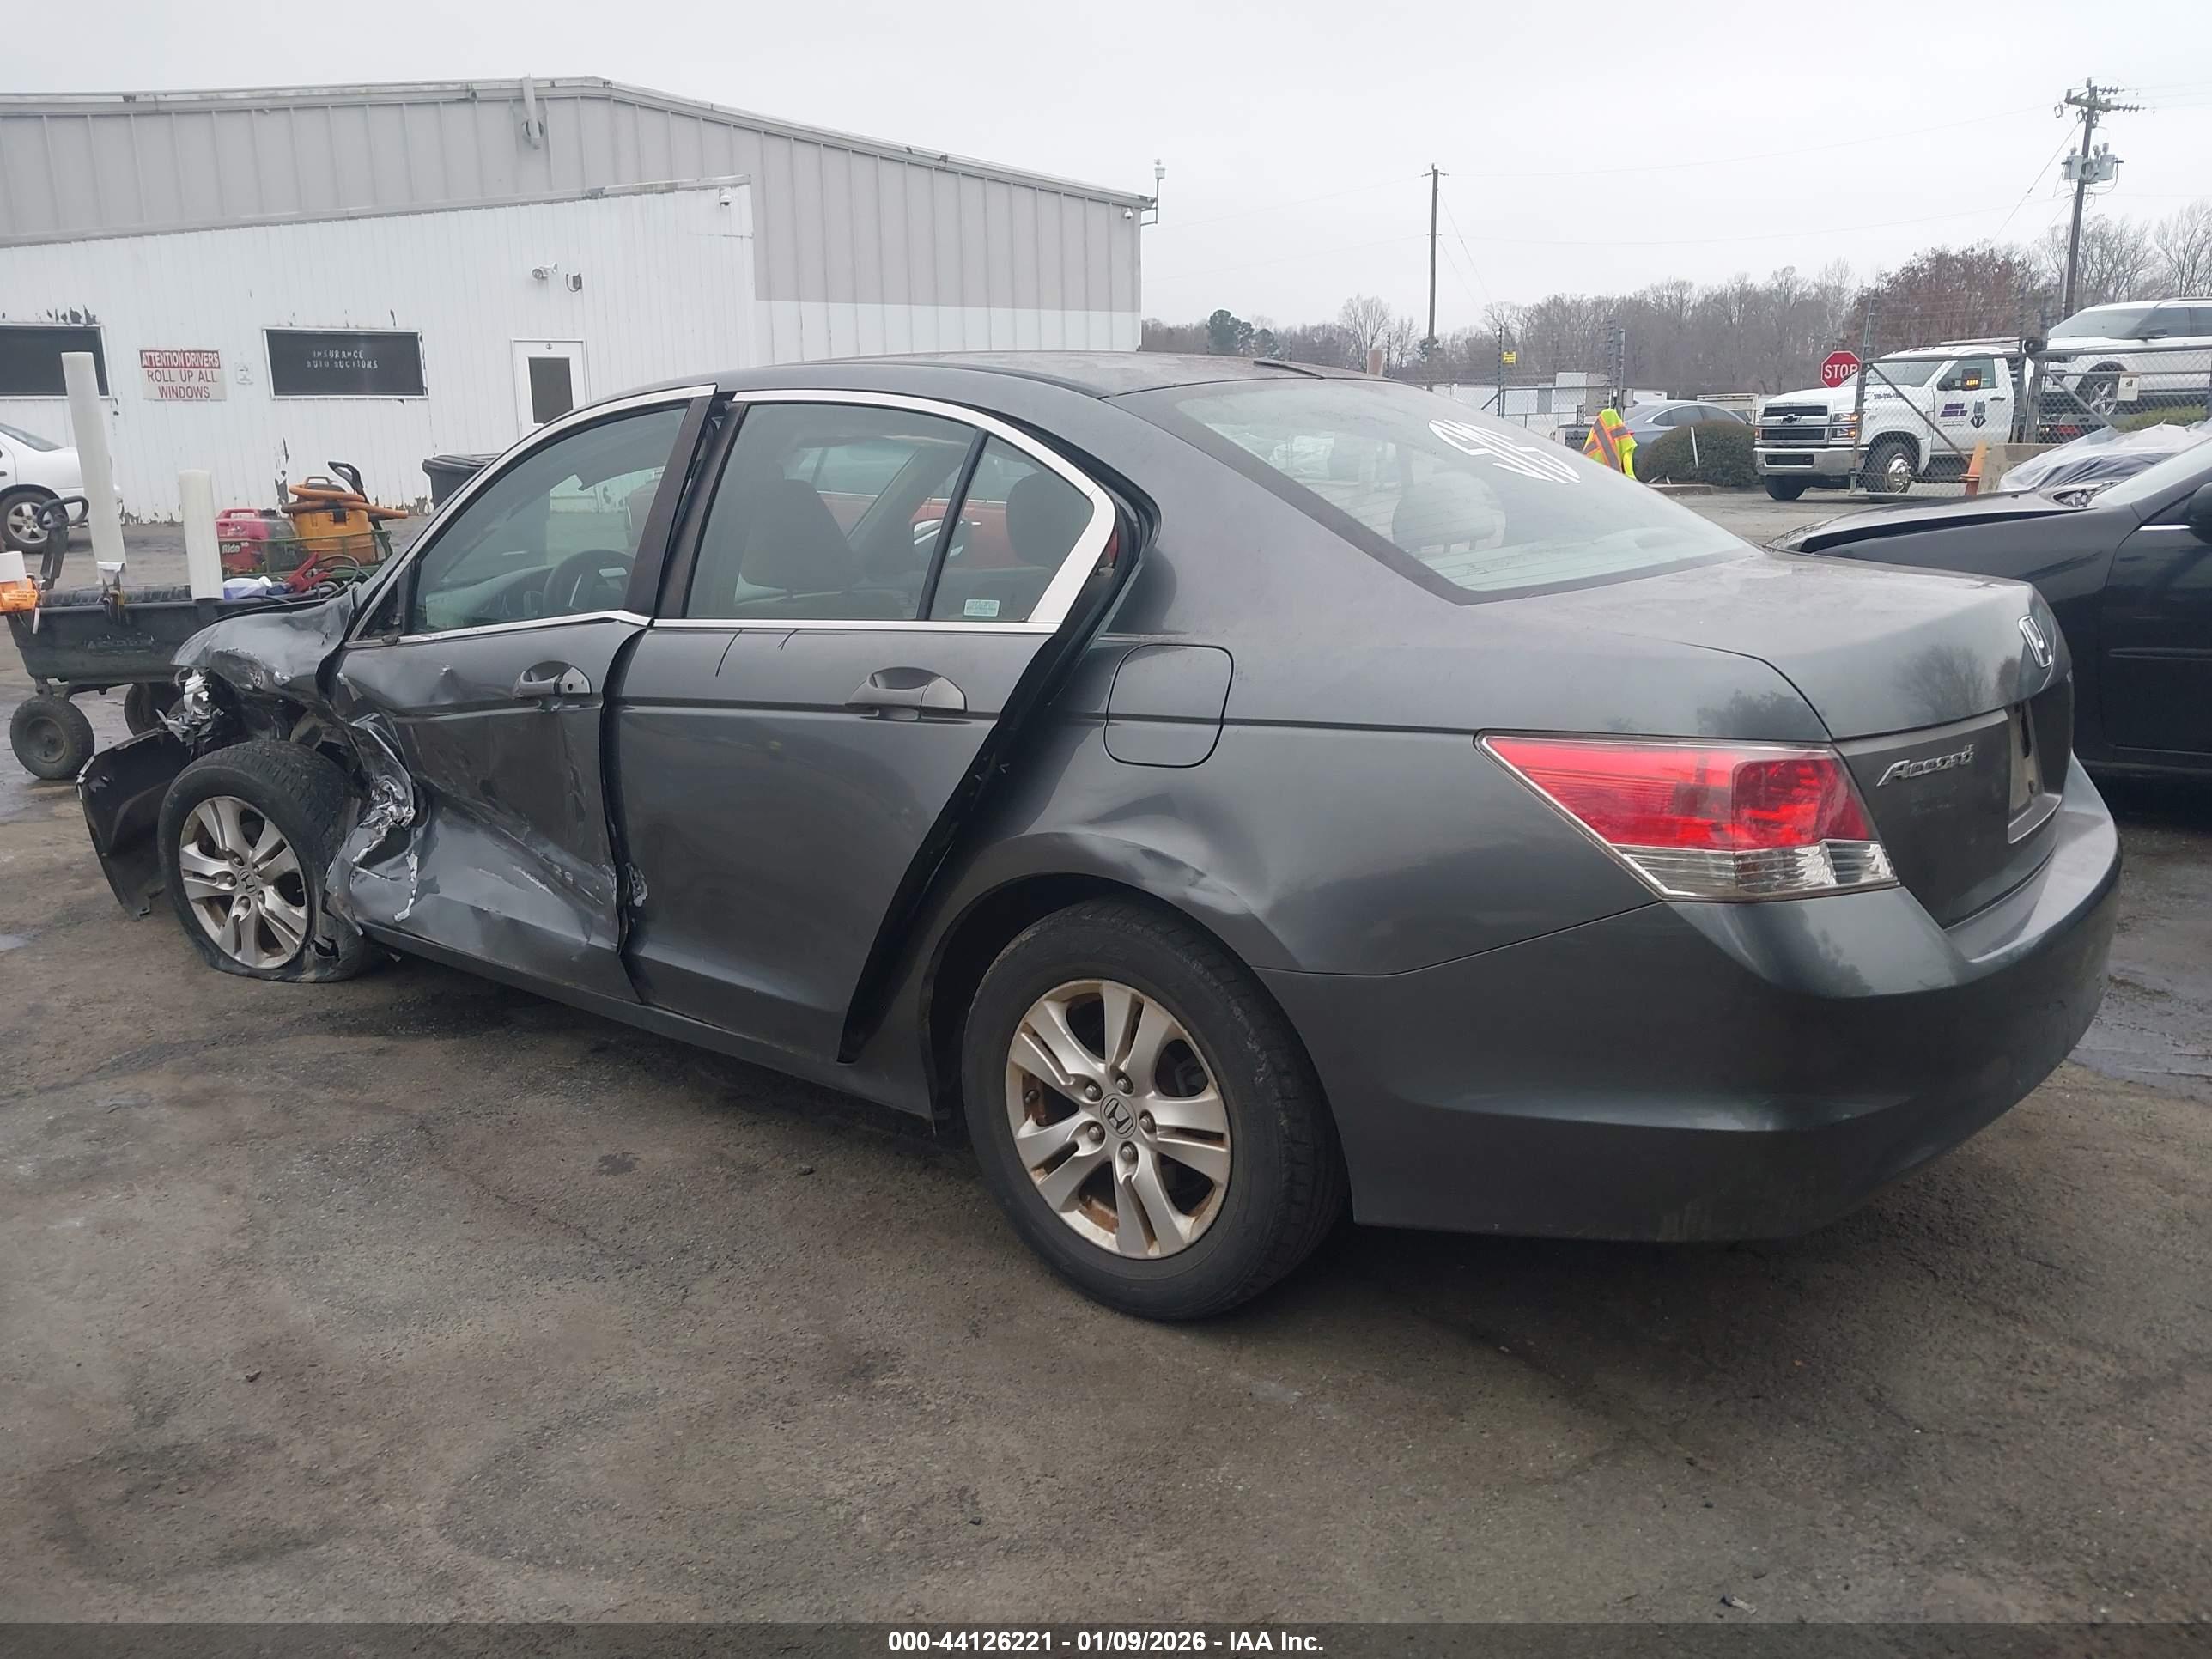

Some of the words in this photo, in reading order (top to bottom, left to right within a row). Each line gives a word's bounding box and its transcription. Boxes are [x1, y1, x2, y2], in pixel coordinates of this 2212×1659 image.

[142, 351, 184, 367] ATTENTION
[185, 352, 219, 368] DRIVERS
[147, 369, 176, 383] ROLL
[179, 369, 194, 383] UP
[198, 369, 218, 383] ALL
[1824, 363, 1858, 380] STOP
[158, 386, 210, 398] WINDOWS
[1876, 744, 1975, 787] Accord
